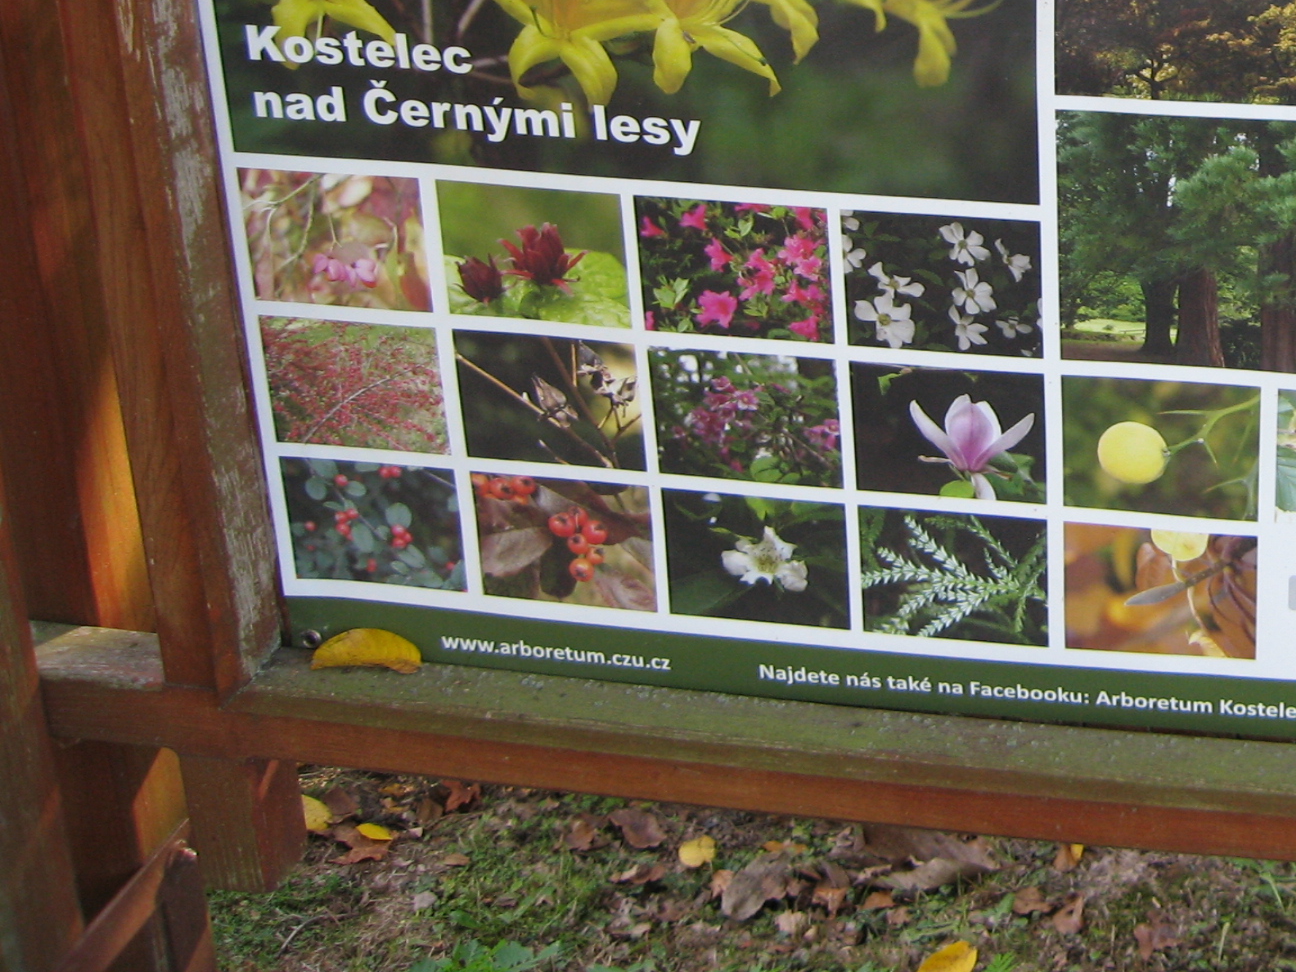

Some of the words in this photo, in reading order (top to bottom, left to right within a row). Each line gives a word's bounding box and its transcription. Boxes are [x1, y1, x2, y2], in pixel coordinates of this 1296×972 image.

[246, 24, 472, 75] Kostelec
[254, 85, 345, 124] nad
[364, 82, 575, 145] Černými
[595, 103, 700, 156] lesy
[441, 633, 672, 672] www.arboretum.czu.cz
[758, 662, 840, 690] Najdete
[846, 668, 882, 691] nás
[888, 671, 932, 695] také
[938, 680, 964, 698] na
[970, 676, 1090, 706] Facebooku:
[1096, 687, 1214, 715] Arboretum
